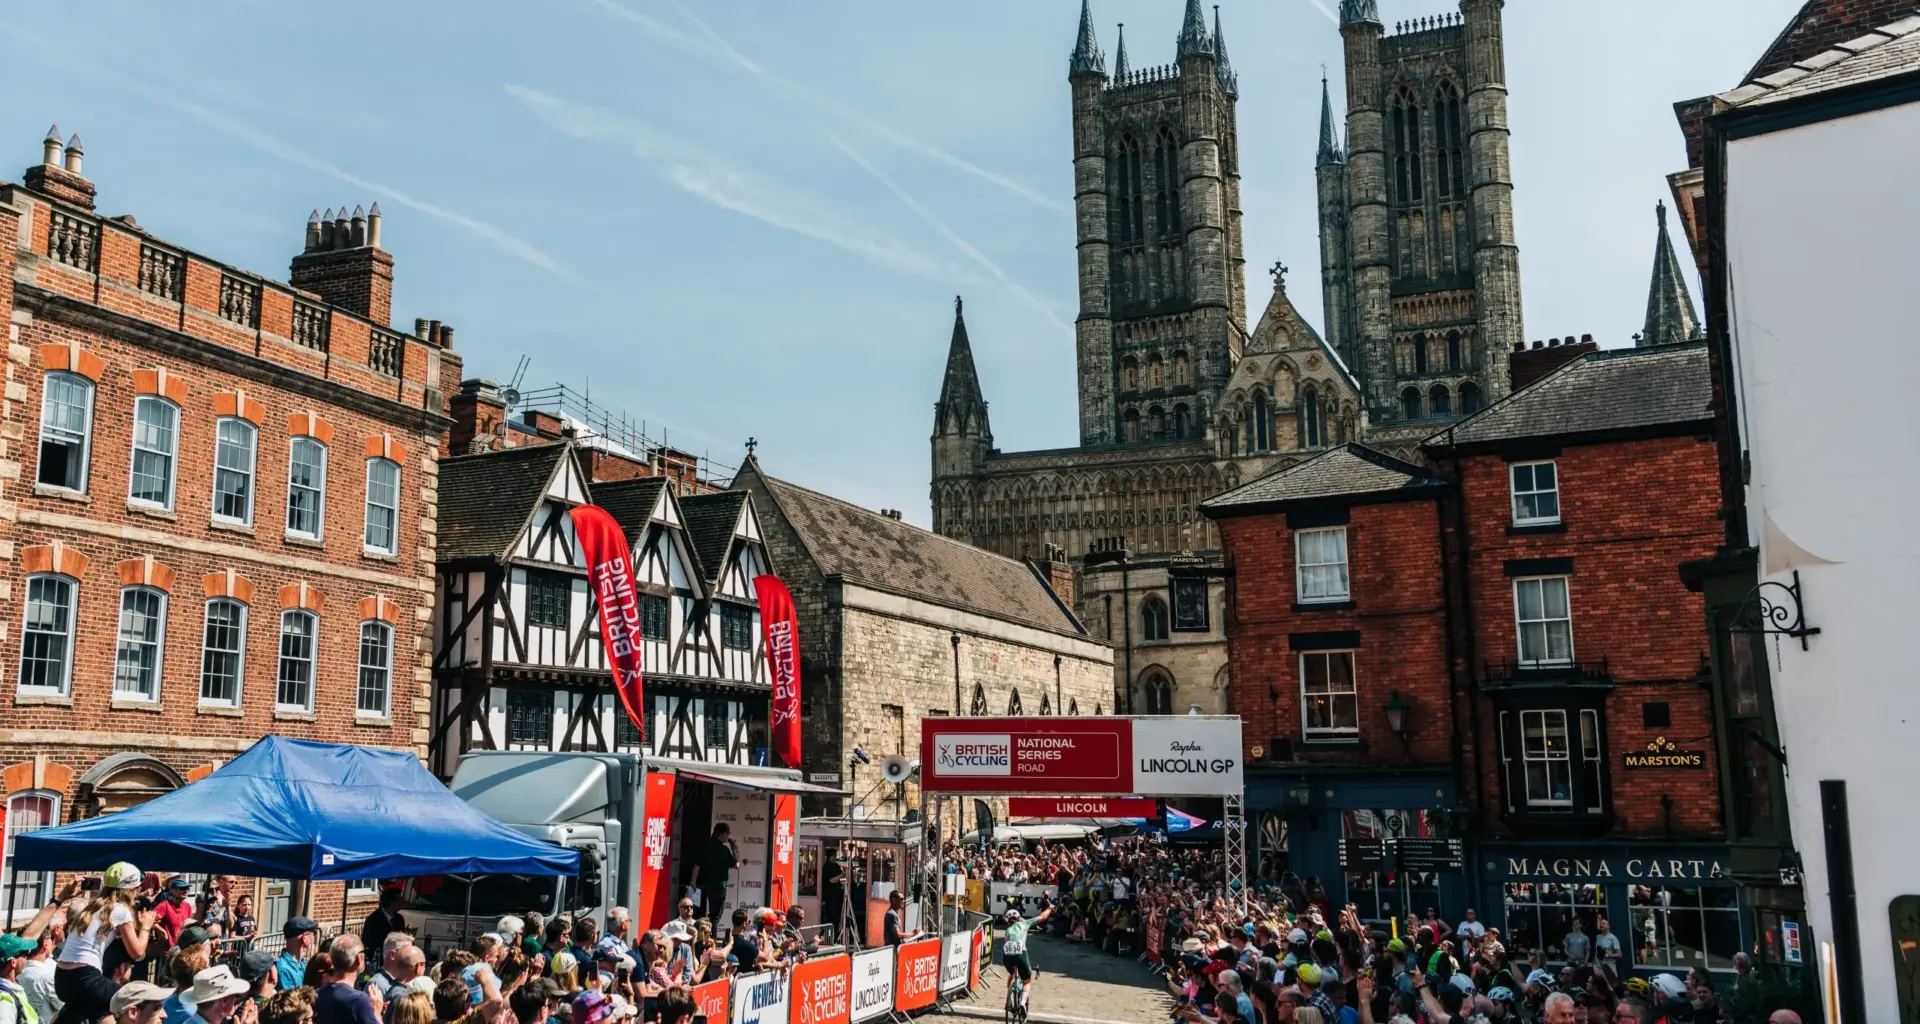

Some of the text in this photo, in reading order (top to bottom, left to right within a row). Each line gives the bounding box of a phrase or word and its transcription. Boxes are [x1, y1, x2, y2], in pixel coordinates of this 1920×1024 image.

[595, 562, 632, 658] BRITISH
[608, 557, 643, 651] CYCLING
[780, 619, 797, 698] CYCLING
[955, 744, 1008, 755] BRITISH
[1017, 738, 1076, 748] NATIONAL
[955, 755, 1008, 766] CYCLING
[1017, 750, 1062, 760] SERIES
[1625, 755, 1701, 766] MARSTON'S
[1017, 763, 1045, 772] ROAD
[1141, 759, 1235, 773] LINCOLN GP
[1056, 803, 1107, 813] LINCOLN
[1508, 858, 1724, 879] MAGNA CARTA
[914, 955, 938, 974] BRITISH
[814, 973, 847, 1001] BRITISH
[913, 972, 937, 995] CYCLING
[855, 982, 890, 1011] LINCOLN GP
[814, 994, 846, 1022] CYCLING
